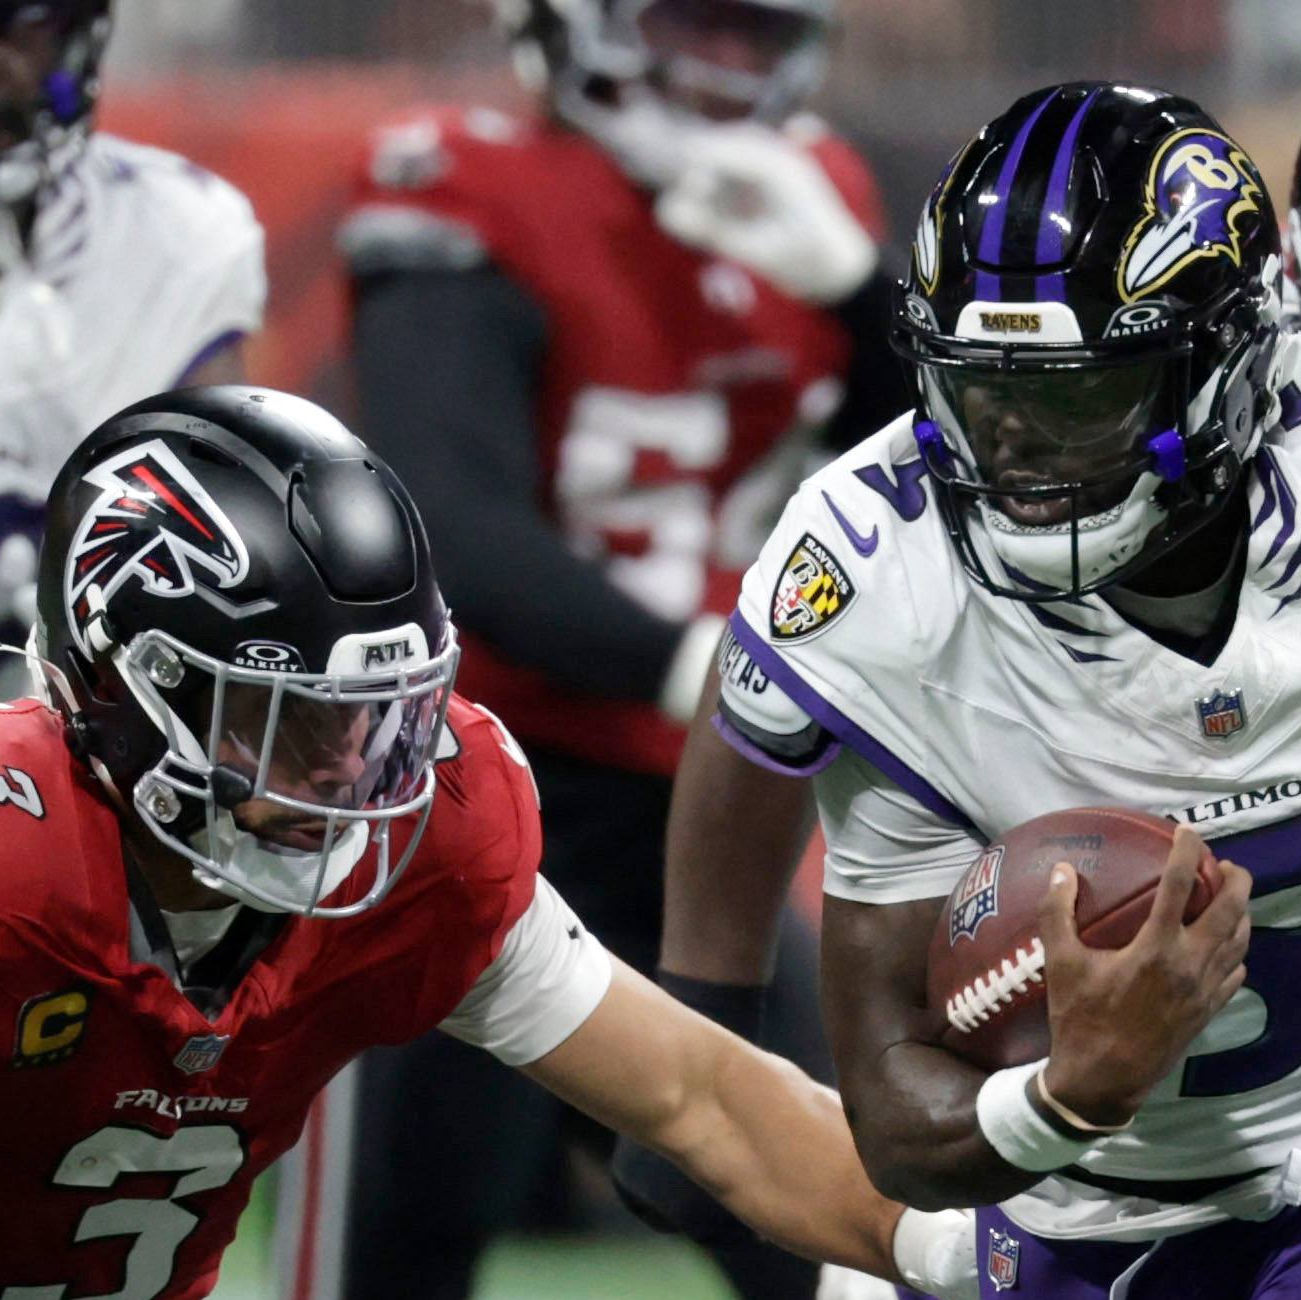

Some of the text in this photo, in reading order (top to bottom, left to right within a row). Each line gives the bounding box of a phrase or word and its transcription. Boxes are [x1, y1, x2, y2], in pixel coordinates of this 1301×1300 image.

[979, 311, 1042, 333] RAVENS
[1110, 318, 1170, 338] OAKLEY
[802, 535, 851, 597] RAVENS
[234, 656, 299, 673] OAKLEY
[362, 639, 414, 671] ATL
[1205, 712, 1242, 737] NFL
[20, 991, 88, 1057] C
[992, 1253, 1012, 1280] NFL
